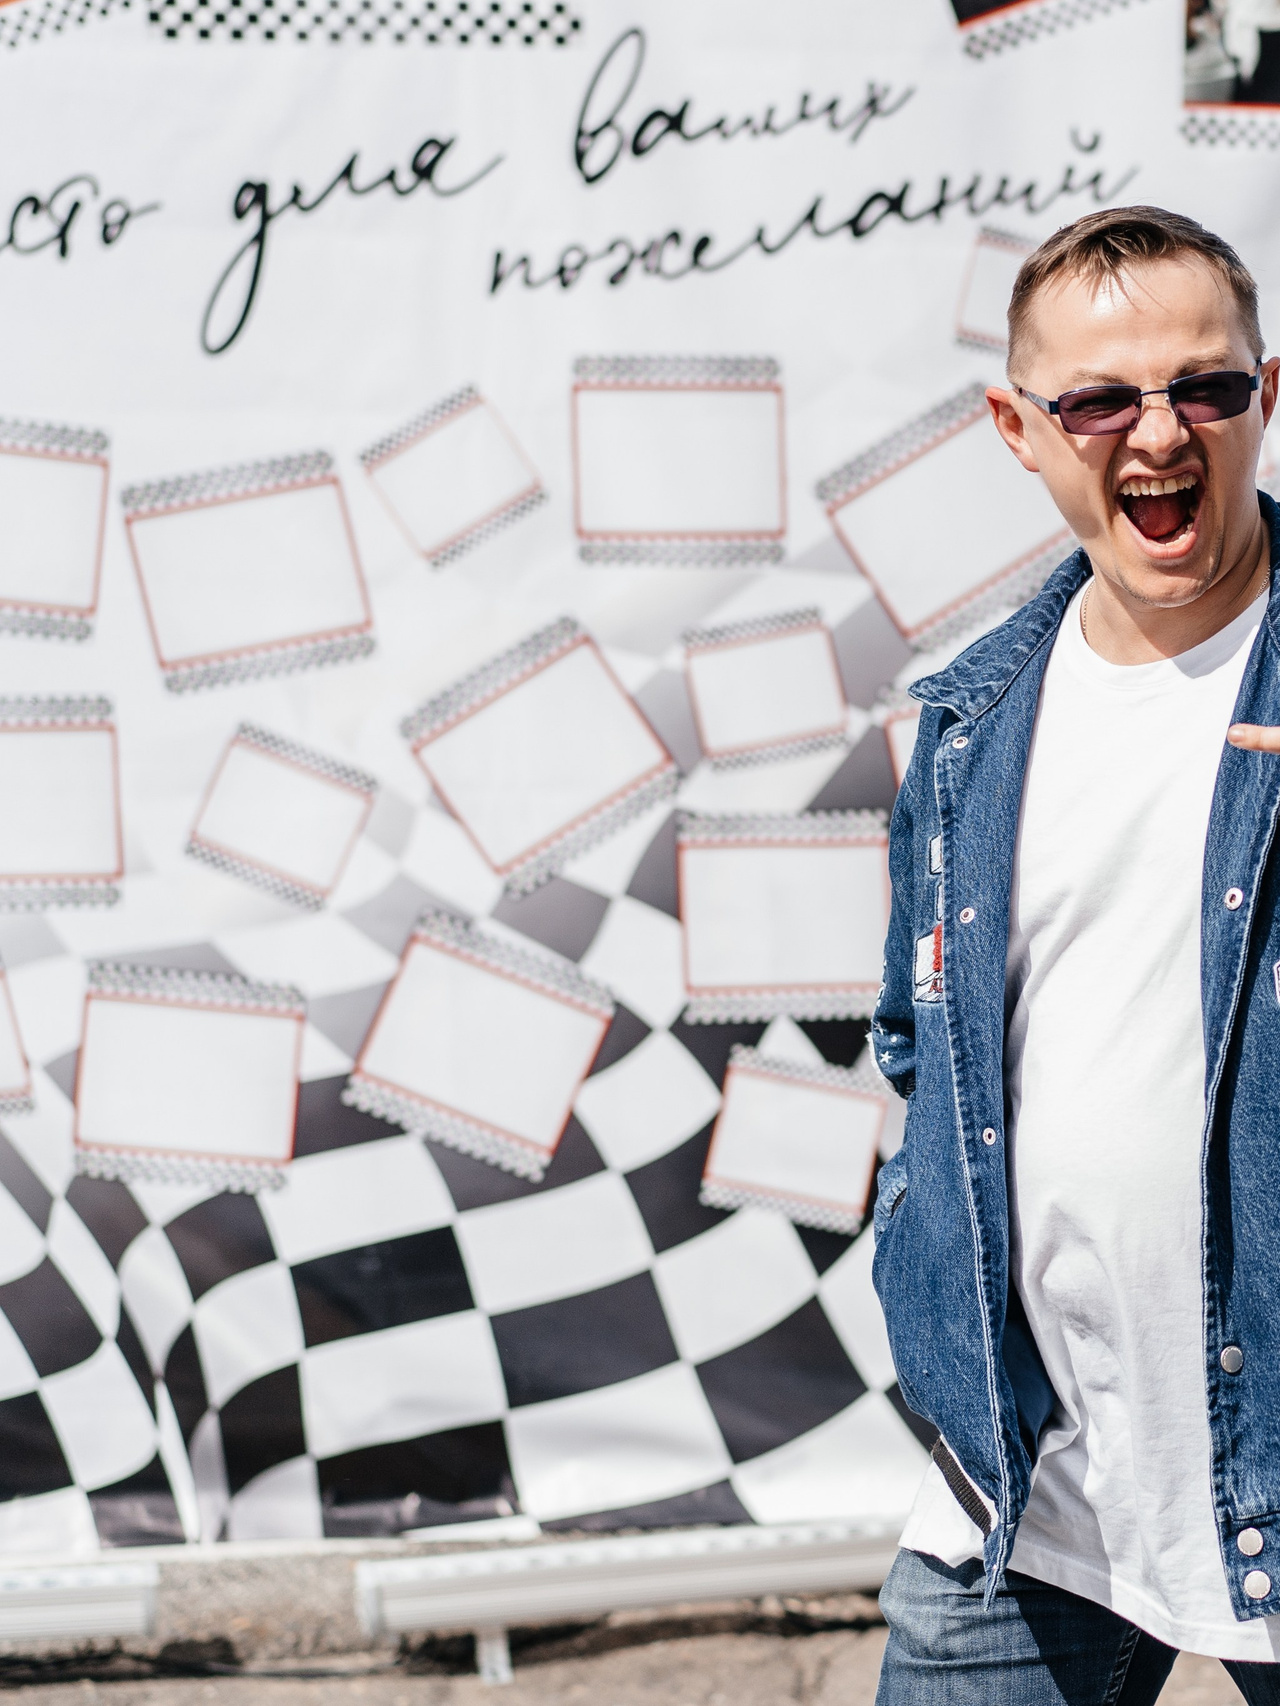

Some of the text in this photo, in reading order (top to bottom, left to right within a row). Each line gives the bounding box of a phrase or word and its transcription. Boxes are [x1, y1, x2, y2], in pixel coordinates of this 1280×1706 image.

[0, 26, 917, 357] сто для ваших
[489, 126, 1141, 297] пожеланий
